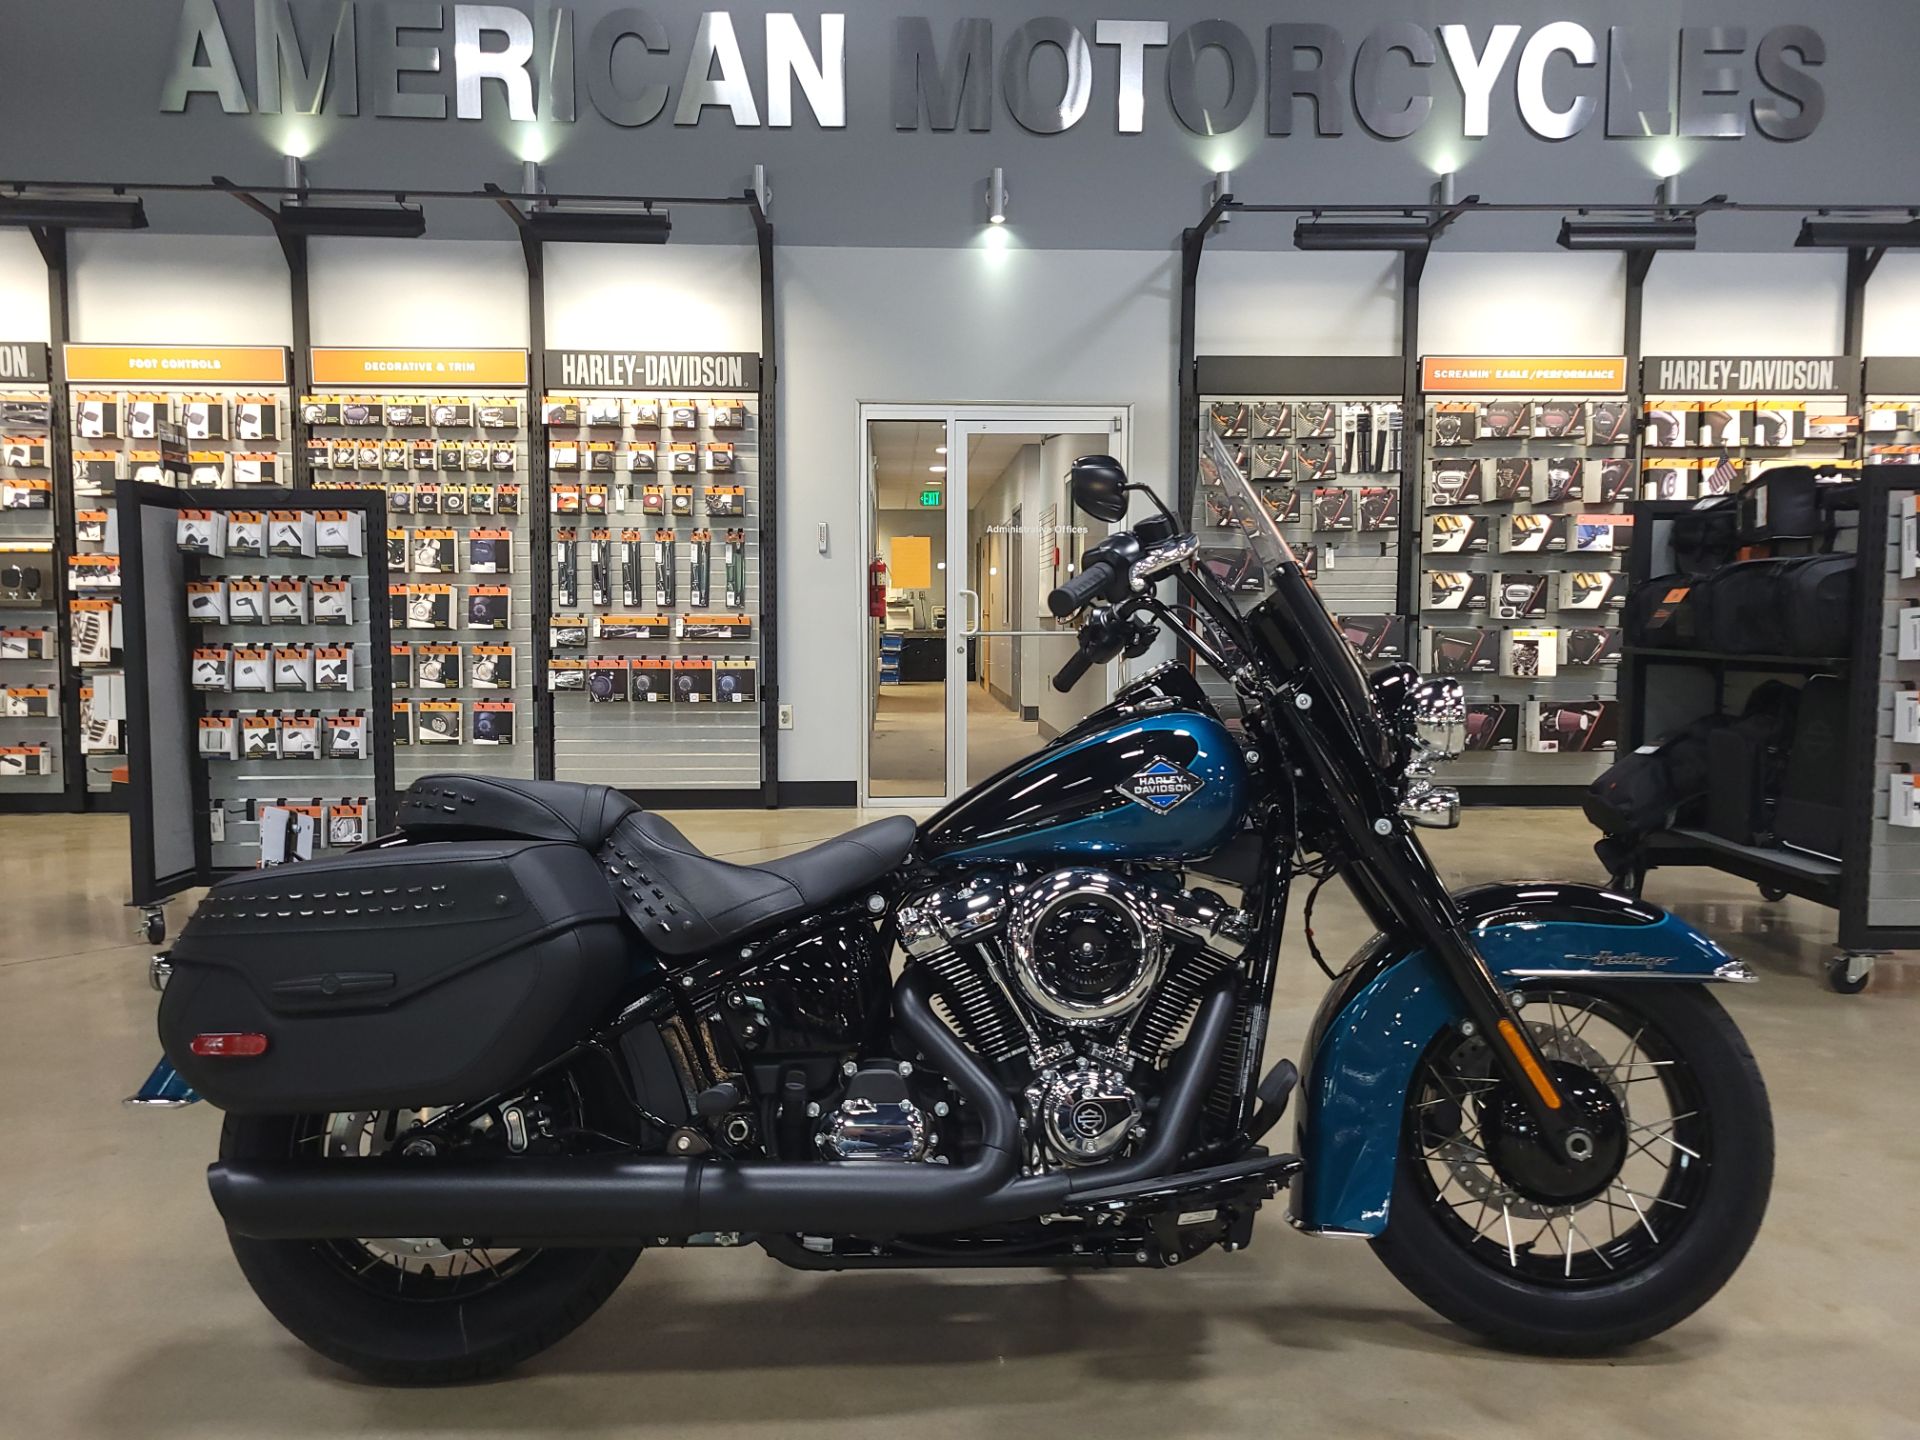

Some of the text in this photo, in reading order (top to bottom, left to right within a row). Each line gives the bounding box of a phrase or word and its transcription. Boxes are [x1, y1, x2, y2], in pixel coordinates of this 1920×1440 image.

[160, 0, 1827, 141] AMERICAN MOTORCYCLES
[128, 358, 222, 370] FOOT CONTROLS
[364, 361, 476, 372] DECORATIVE & TRIM
[562, 353, 742, 387] HARLEY-DAVIDSON
[1433, 369, 1492, 379] SCREAMIN'
[1659, 359, 1834, 390] HARLEY-DAVIDSON
[923, 491, 940, 506] EXIT
[1054, 524, 1089, 534] Offices
[1139, 775, 1187, 786] HARLEY-
[1133, 783, 1192, 794] DAVIDSON
